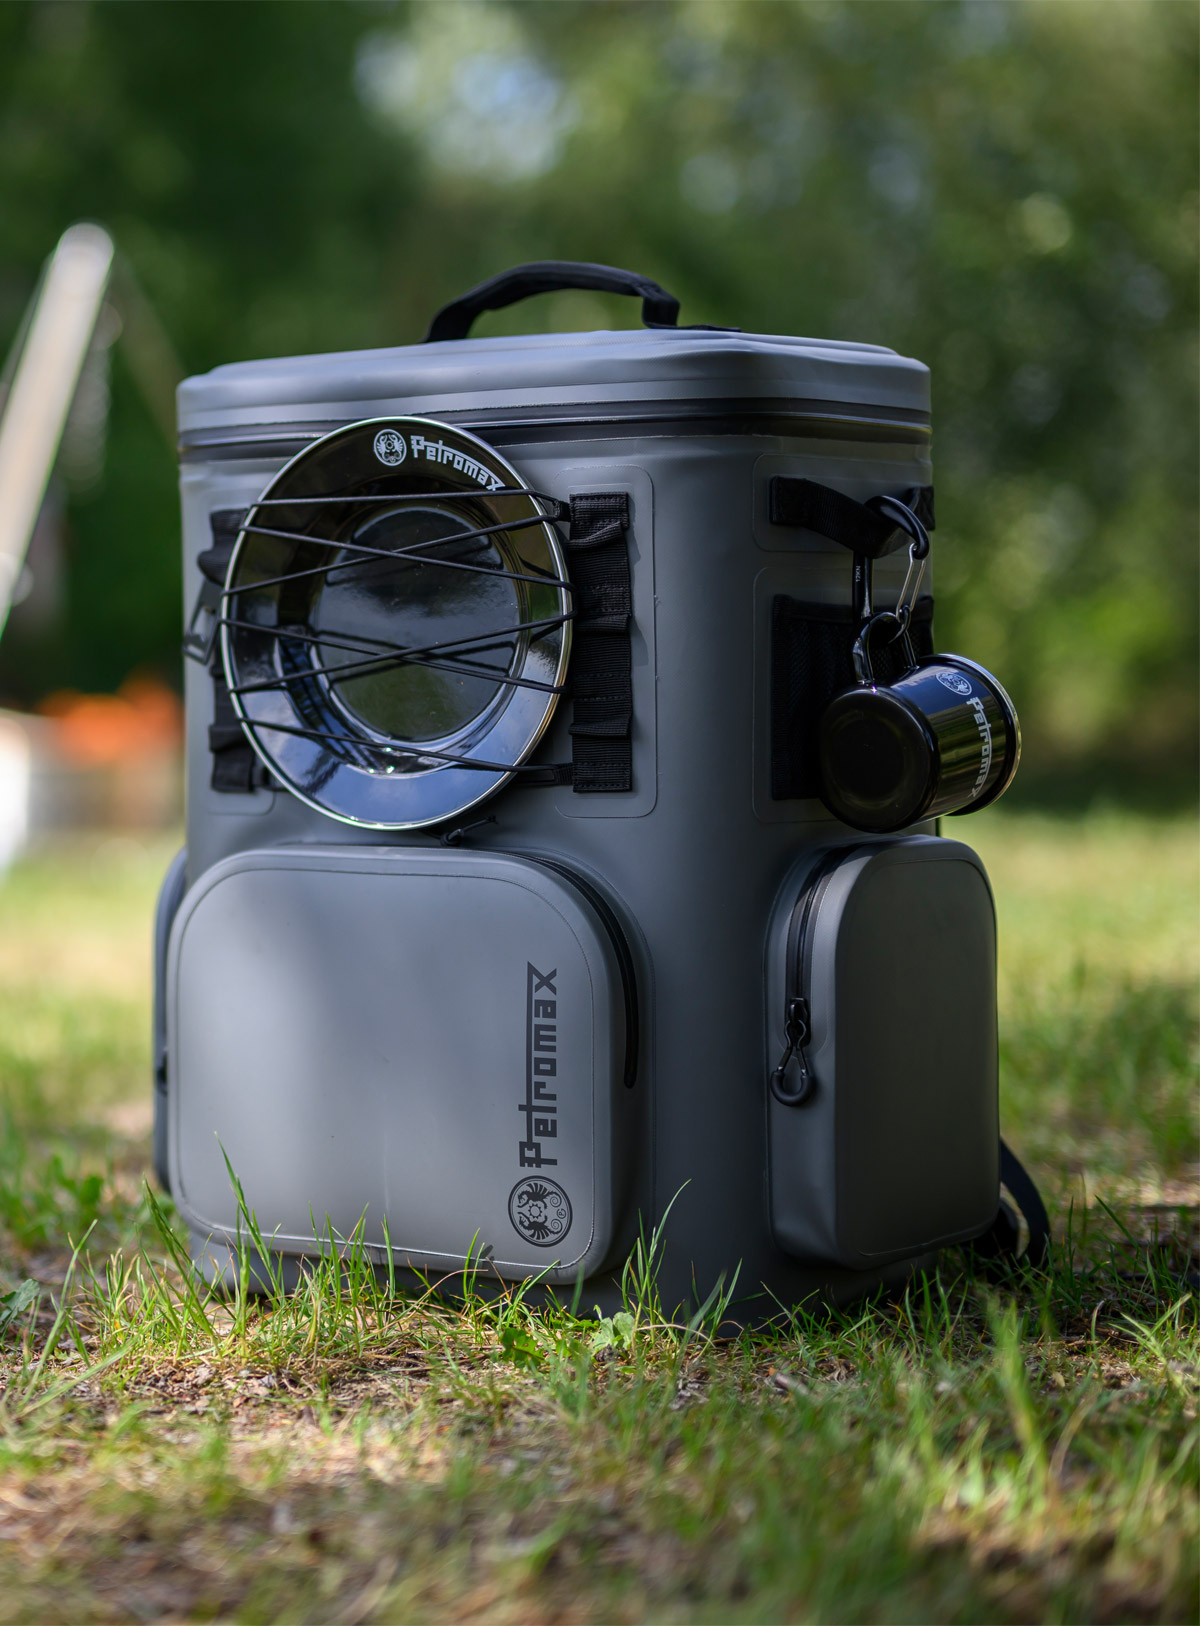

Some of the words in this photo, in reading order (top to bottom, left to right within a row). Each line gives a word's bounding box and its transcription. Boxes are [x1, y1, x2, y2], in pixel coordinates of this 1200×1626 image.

[410, 435, 506, 491] Petromax
[966, 697, 992, 798] Petromax
[518, 961, 558, 1168] Petromax
